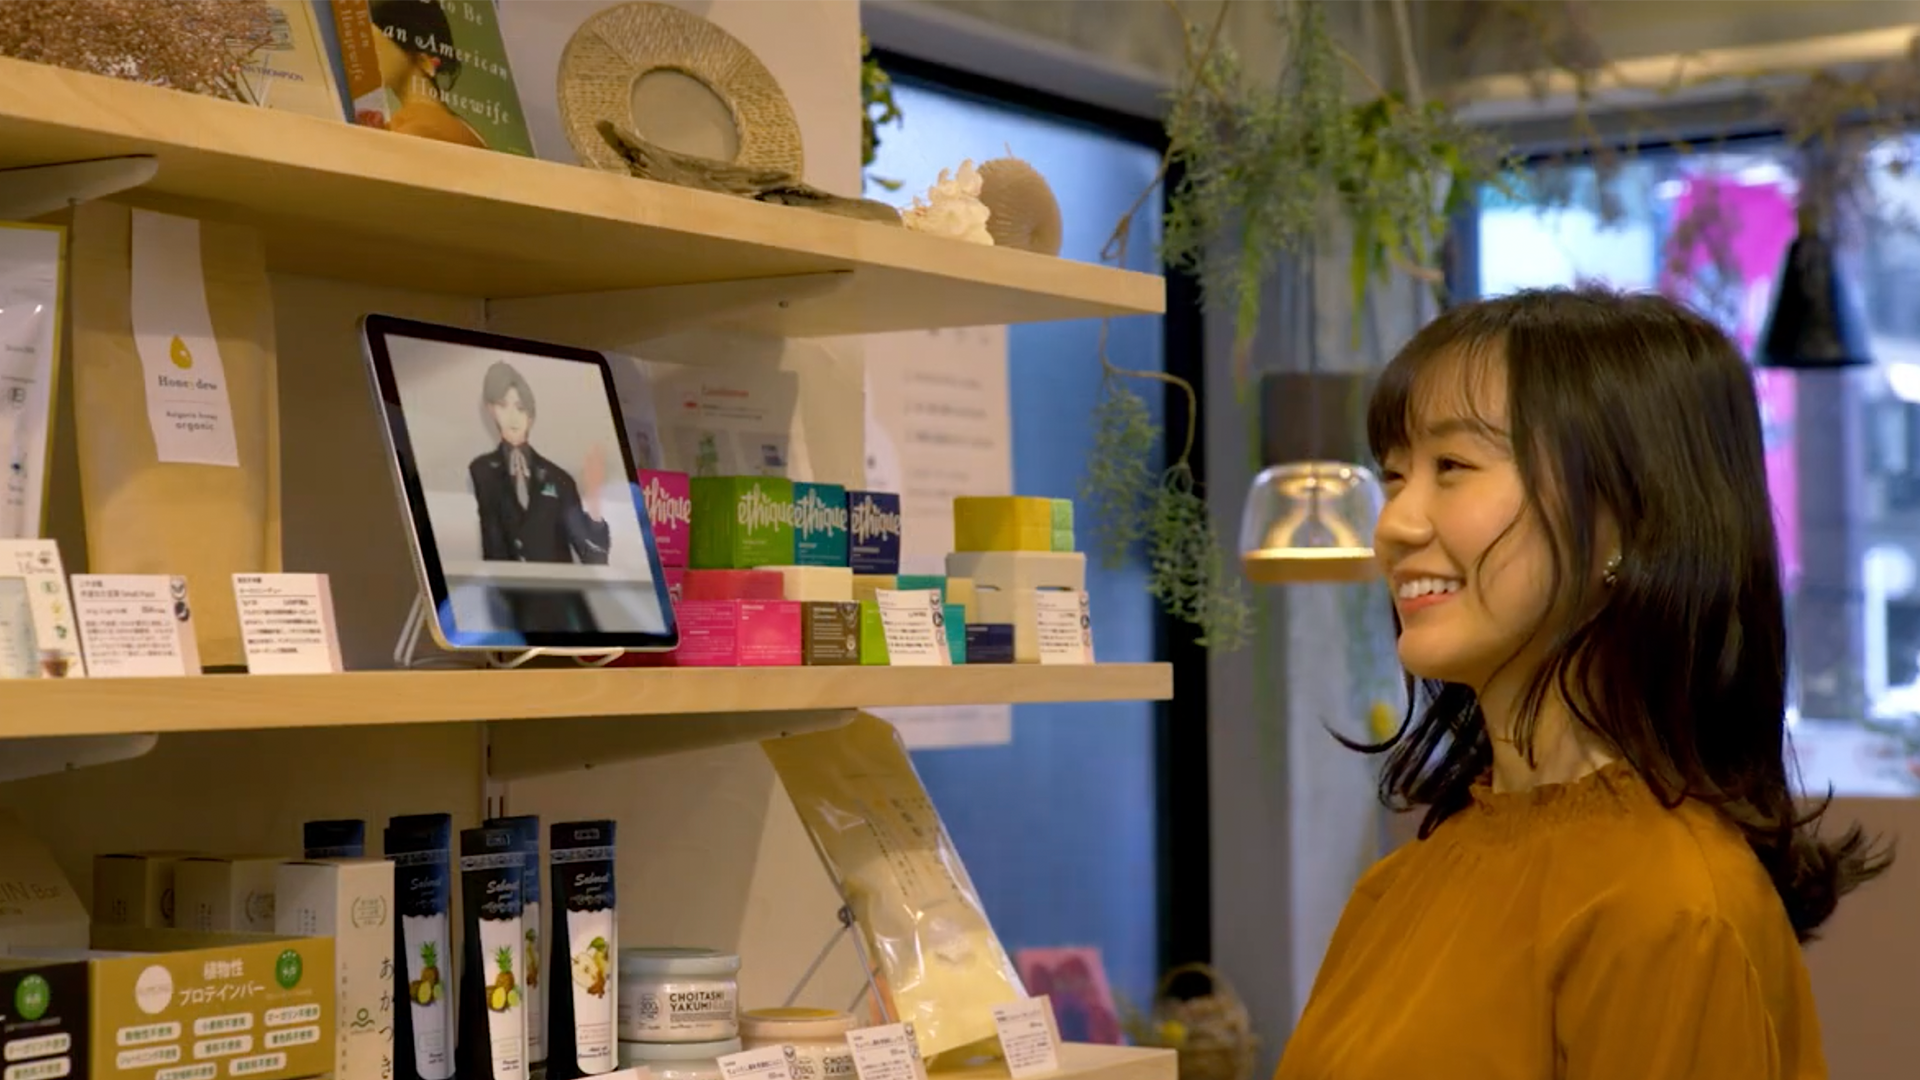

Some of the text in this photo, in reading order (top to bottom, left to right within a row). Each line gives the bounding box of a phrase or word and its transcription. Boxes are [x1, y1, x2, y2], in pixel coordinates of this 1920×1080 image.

[463, 2, 484, 26] Be
[383, 25, 508, 79] an American
[412, 75, 509, 125] Housewife
[175, 421, 215, 433] organic
[643, 477, 691, 530] thique
[737, 483, 793, 536] ethique
[794, 488, 848, 541] ethique
[851, 494, 901, 545] ethique
[203, 958, 245, 981] 植物性
[179, 980, 266, 1007] プロテインバー
[669, 991, 725, 1003] CHOITASHI
[670, 1001, 712, 1013] YAKUMI
